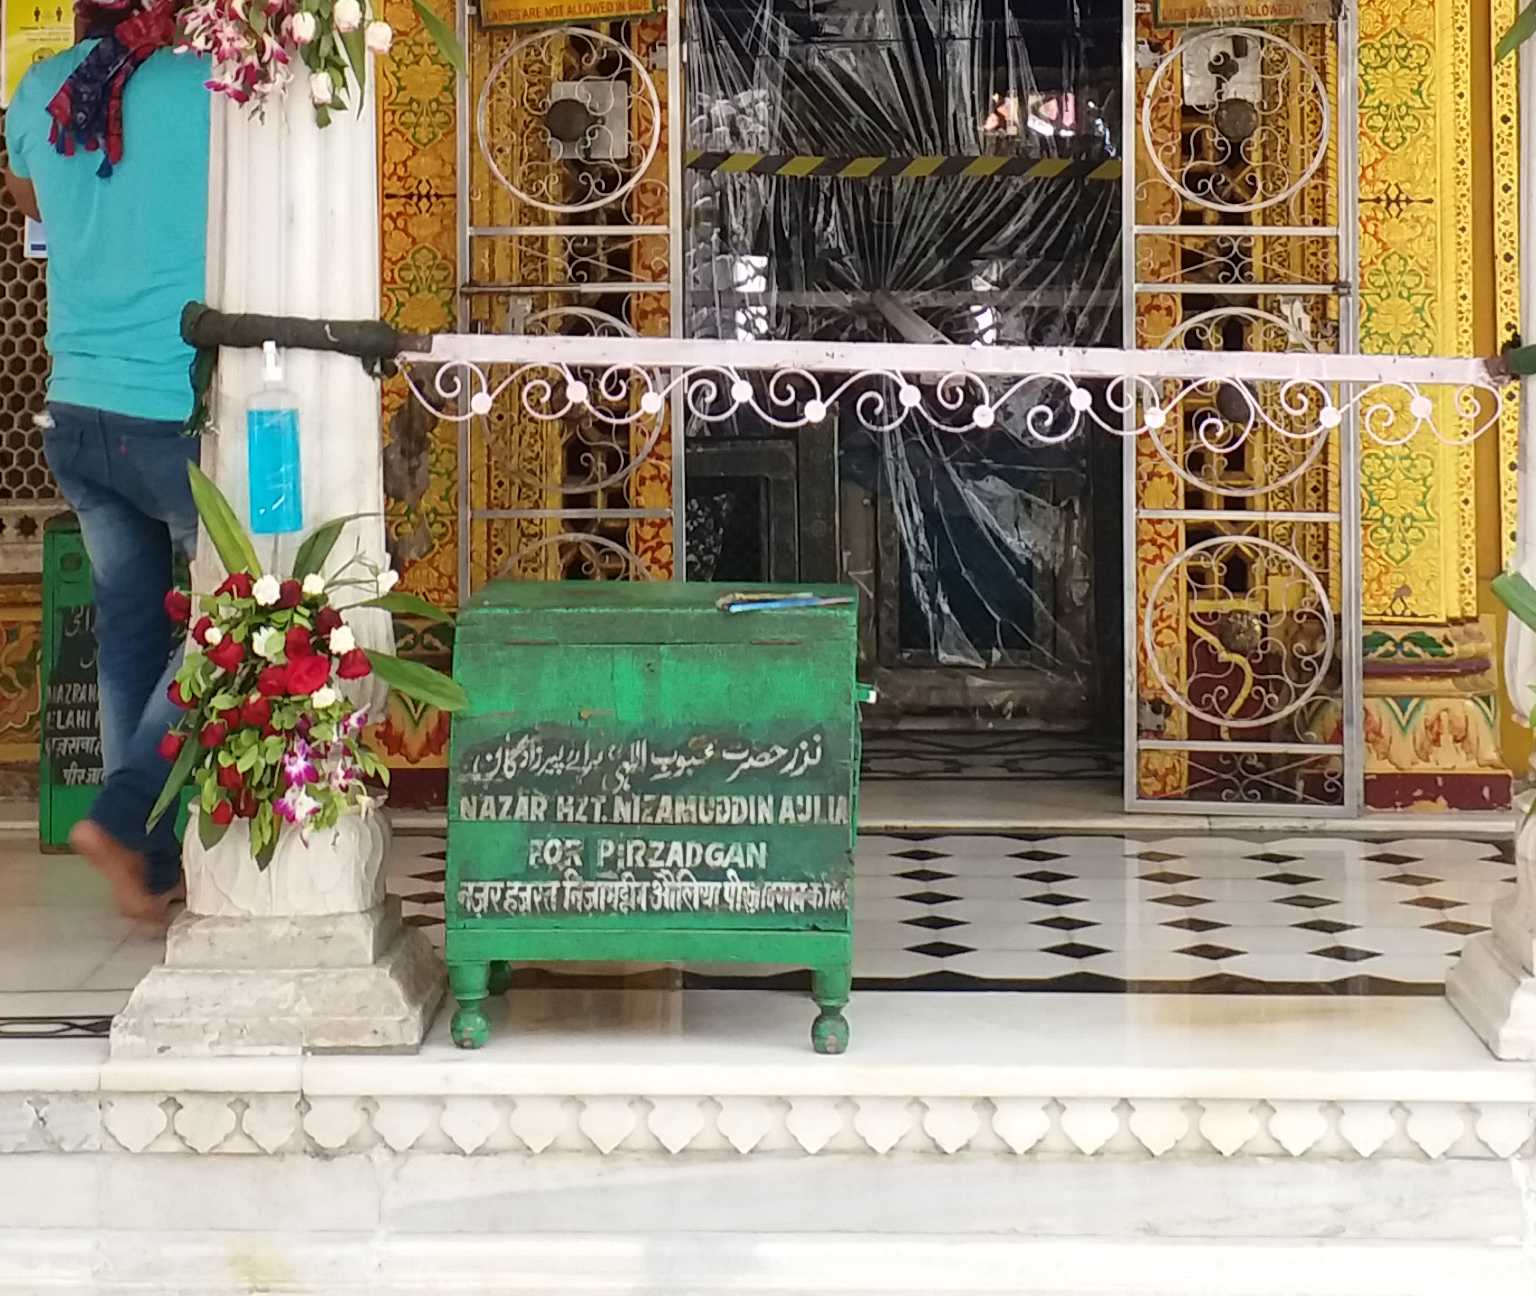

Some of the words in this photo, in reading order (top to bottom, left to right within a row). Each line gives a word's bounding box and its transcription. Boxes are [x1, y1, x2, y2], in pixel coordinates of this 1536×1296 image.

[486, 7, 520, 23] LADIES
[522, 6, 541, 19] ARE
[544, 5, 564, 19] NOT
[566, 1, 613, 16] ALLOWED
[1244, 3, 1293, 17] ALLOWED
[459, 795, 547, 822] NAZAR
[614, 795, 774, 825] NIZAMUDDIN
[778, 795, 849, 825] AULIA
[528, 838, 585, 869] FOR
[597, 838, 769, 870] PIRZADGAN
